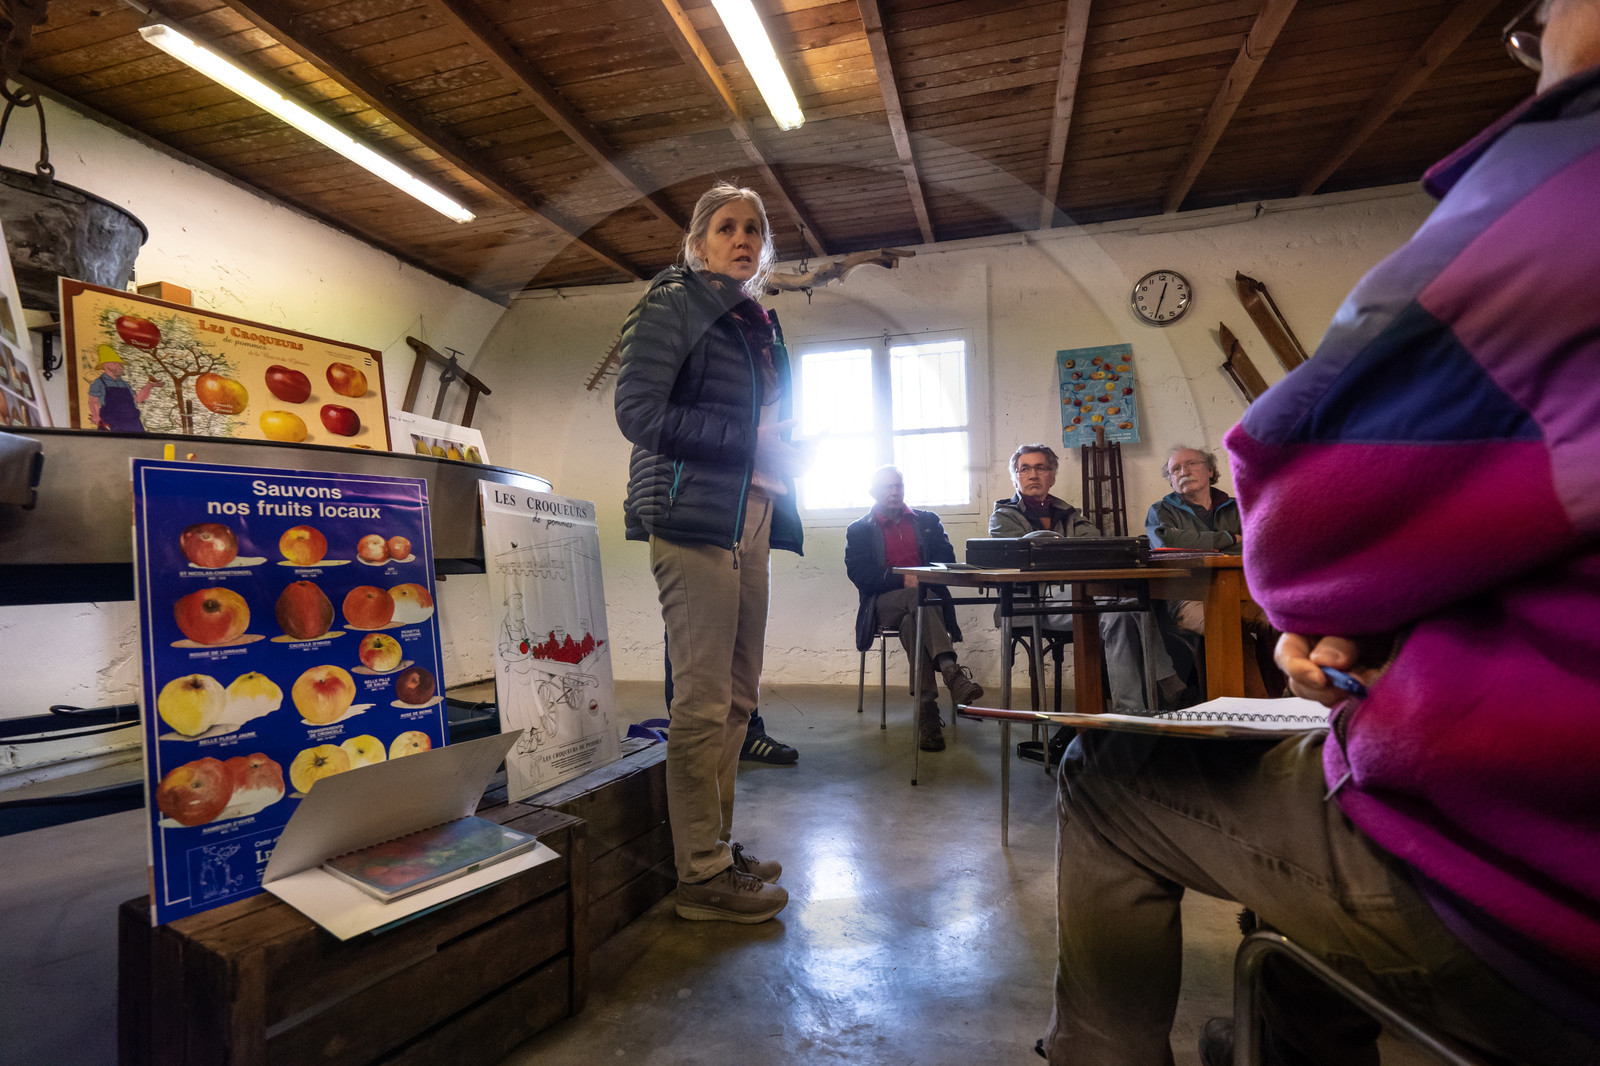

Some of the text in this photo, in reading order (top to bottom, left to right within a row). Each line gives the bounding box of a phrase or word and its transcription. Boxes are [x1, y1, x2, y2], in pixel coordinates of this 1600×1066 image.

[223, 335, 268, 351] de pommes
[230, 326, 304, 351] CROQUEURS
[252, 480, 342, 499] Sauvons
[207, 500, 381, 519] nos fruits locaux
[495, 490, 588, 519] LES CROQUEURS
[532, 511, 573, 531] de pommes
